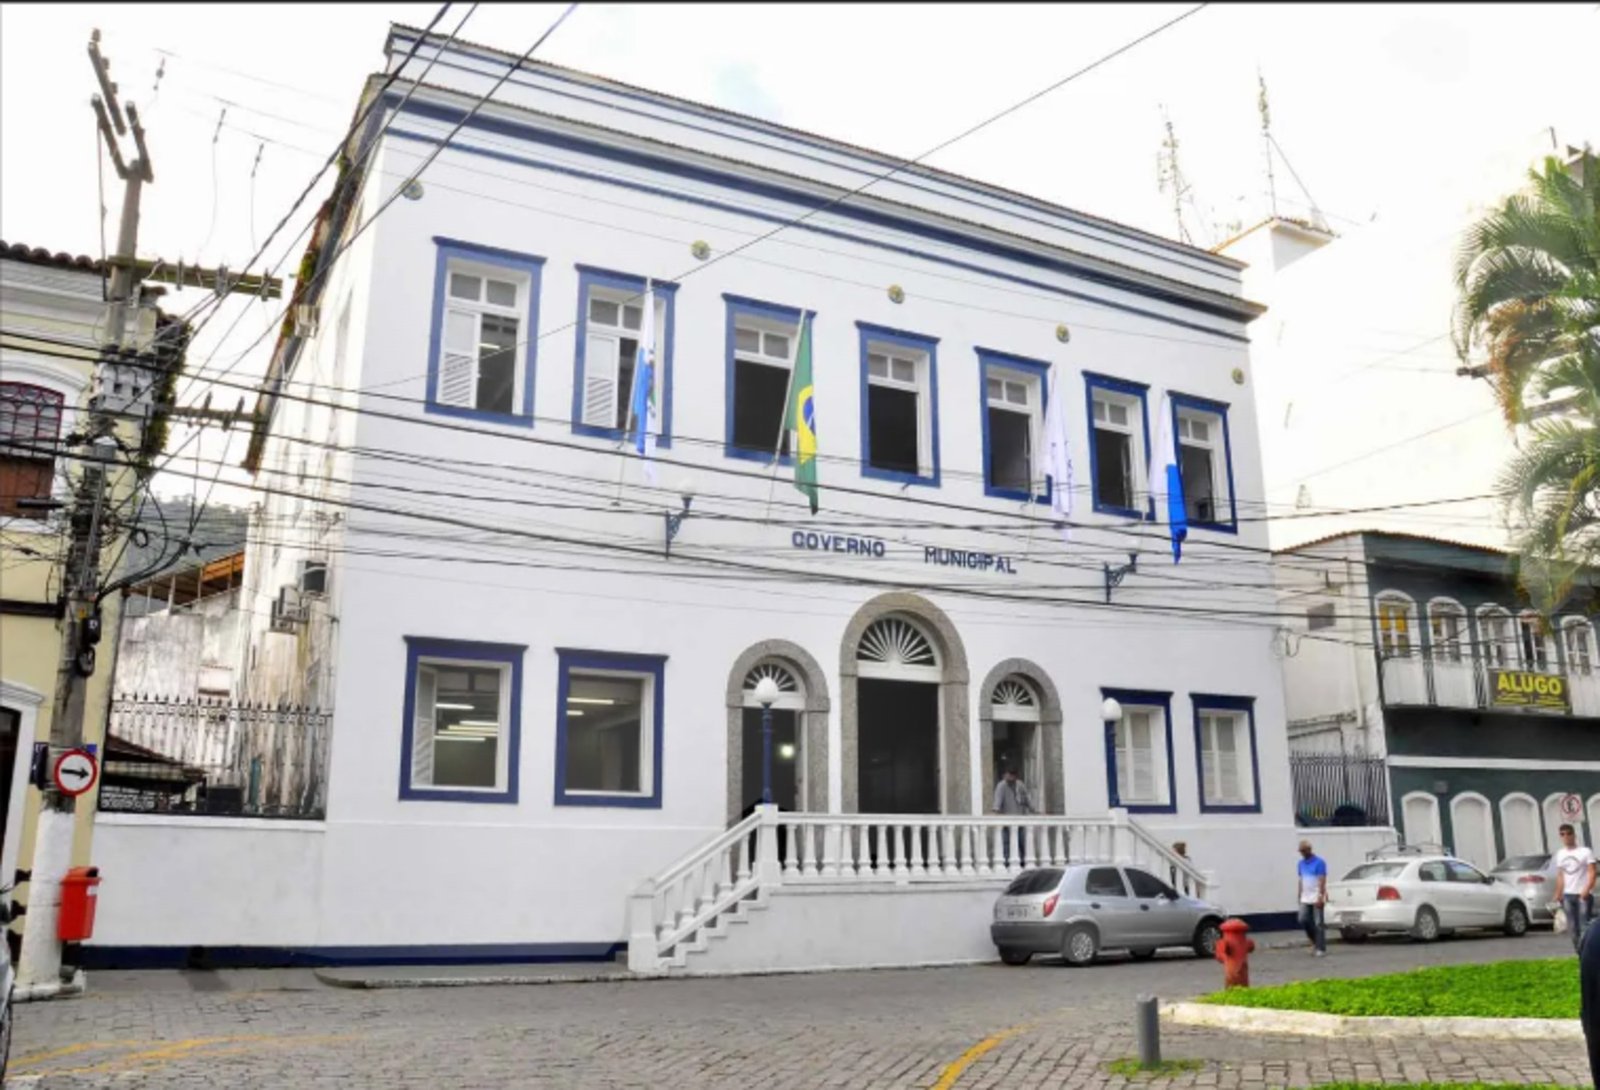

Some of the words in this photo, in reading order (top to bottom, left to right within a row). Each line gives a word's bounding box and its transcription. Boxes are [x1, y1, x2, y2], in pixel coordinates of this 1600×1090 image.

[792, 531, 885, 557] GOVERNO
[925, 546, 1017, 574] MUNICIPAL
[1498, 672, 1562, 695] ALUGO
